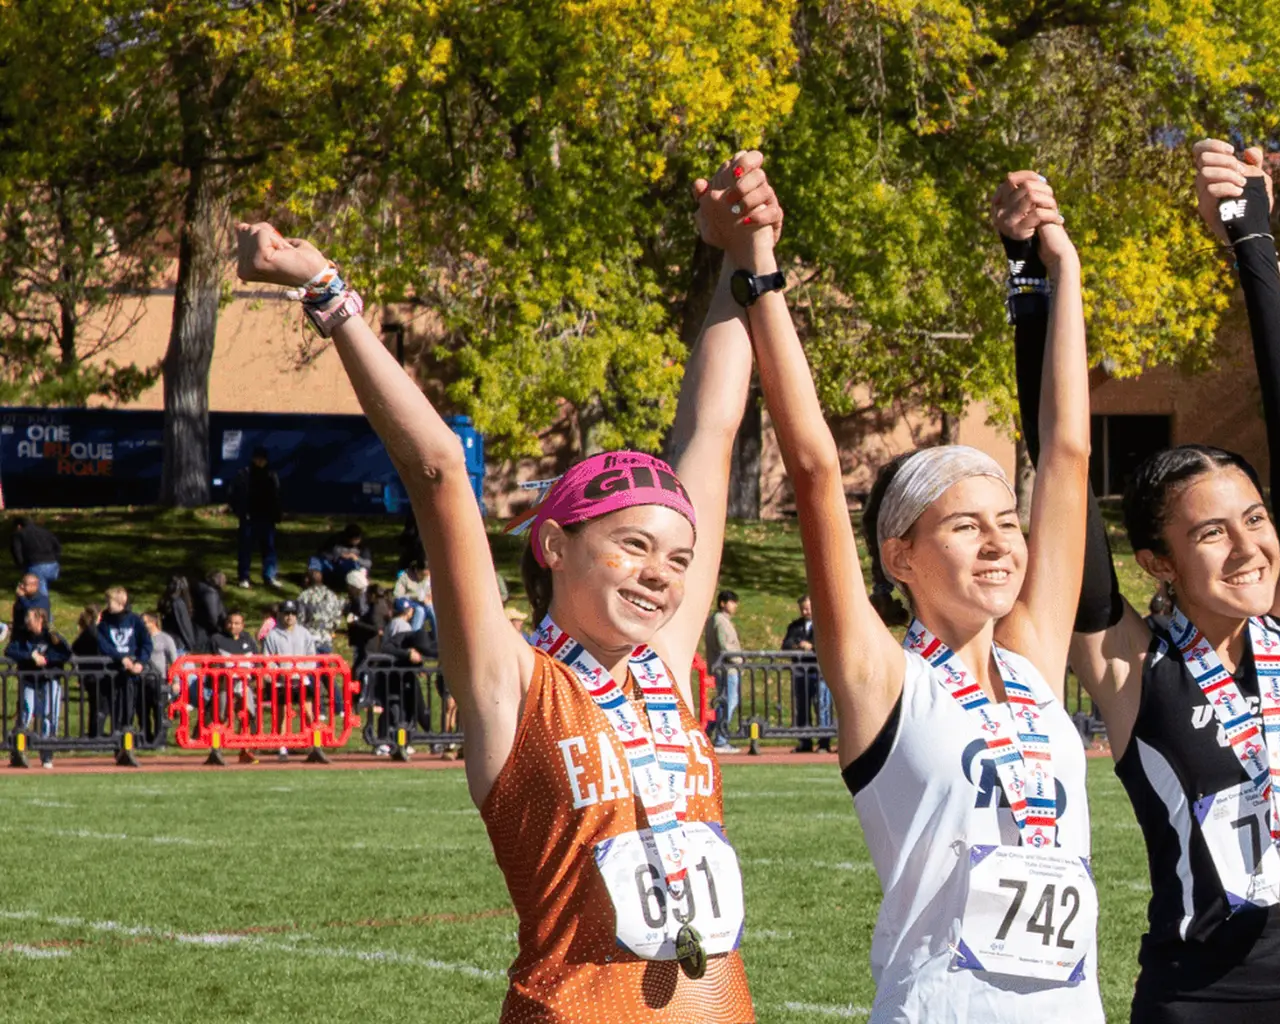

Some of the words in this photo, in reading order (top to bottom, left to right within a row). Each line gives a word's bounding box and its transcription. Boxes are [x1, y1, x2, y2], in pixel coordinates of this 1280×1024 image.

[27, 424, 71, 443] ONE
[634, 854, 722, 929] 691
[995, 878, 1080, 949] 742
